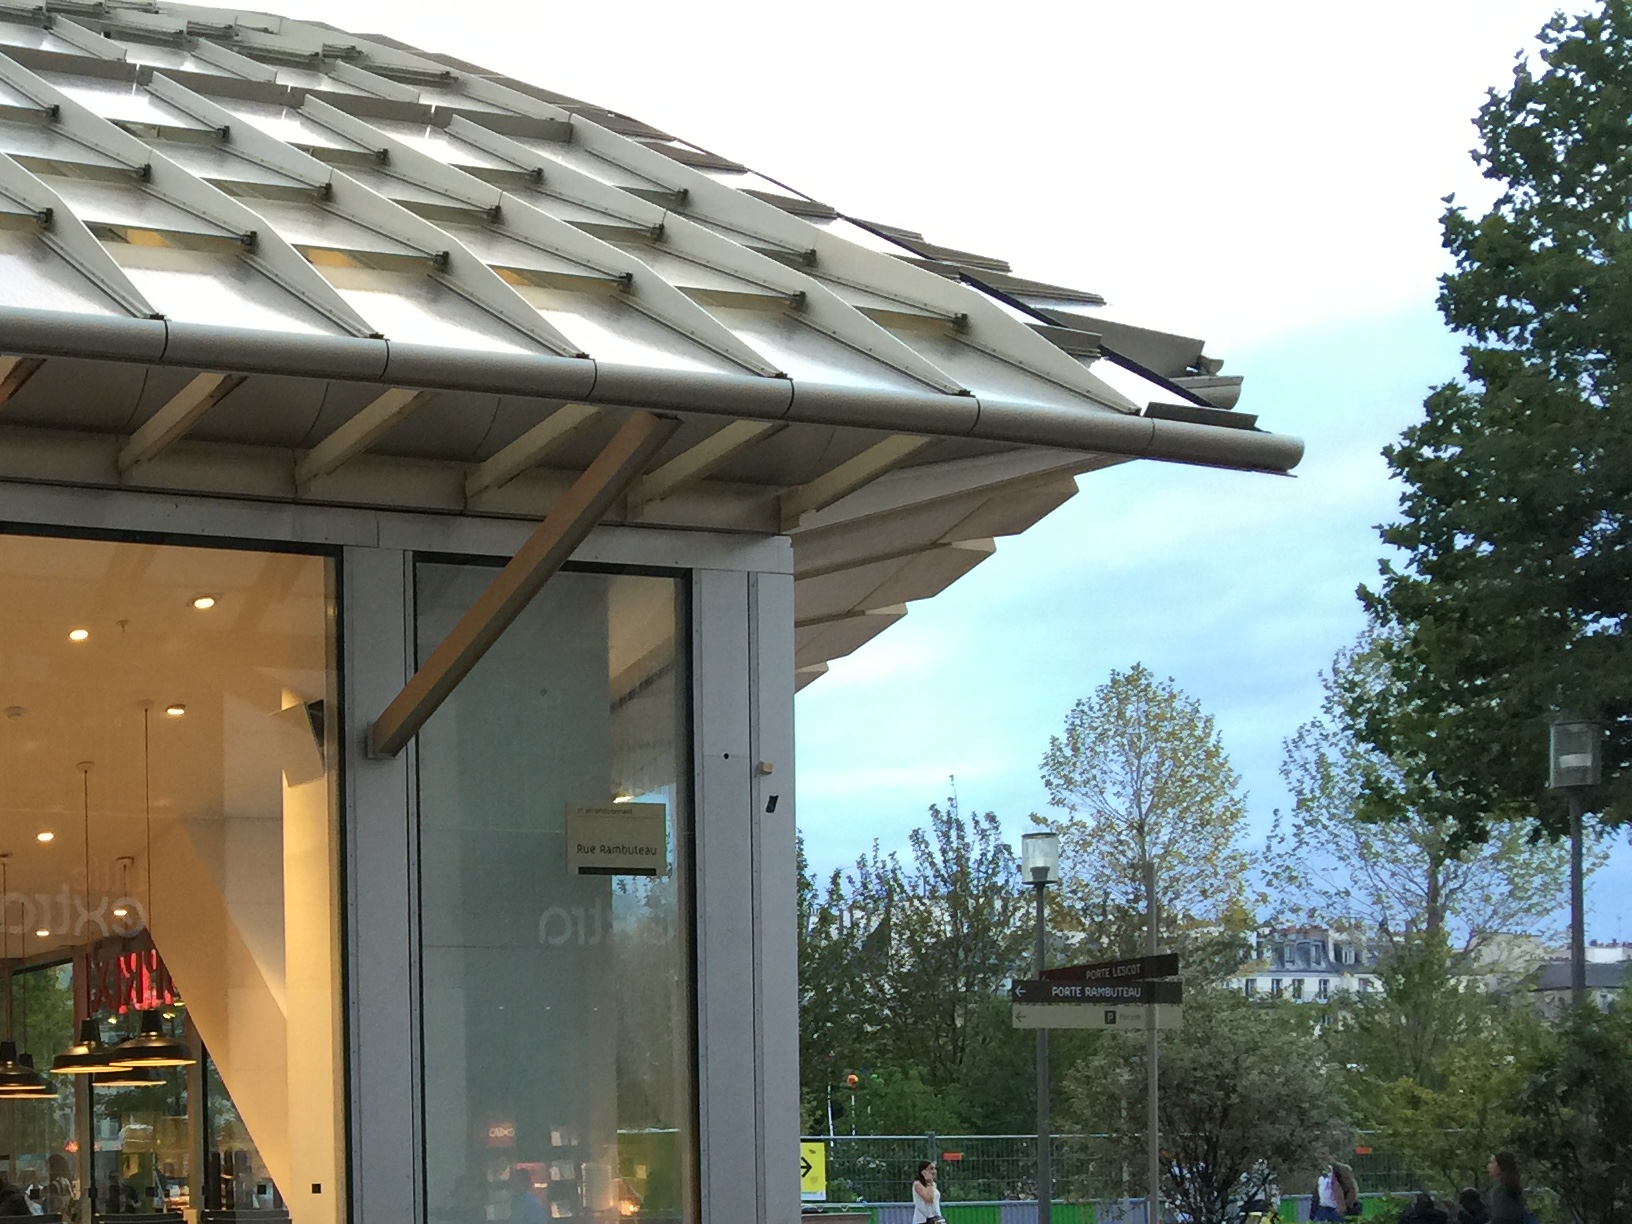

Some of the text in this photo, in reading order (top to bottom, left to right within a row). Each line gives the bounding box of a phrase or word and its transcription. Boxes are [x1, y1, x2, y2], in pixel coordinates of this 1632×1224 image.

[576, 844, 657, 856] Rue Rambuteau
[1085, 963, 1141, 980] PORTE LESCOT
[1051, 986, 1141, 998] PORTE RAMBUTEAU
